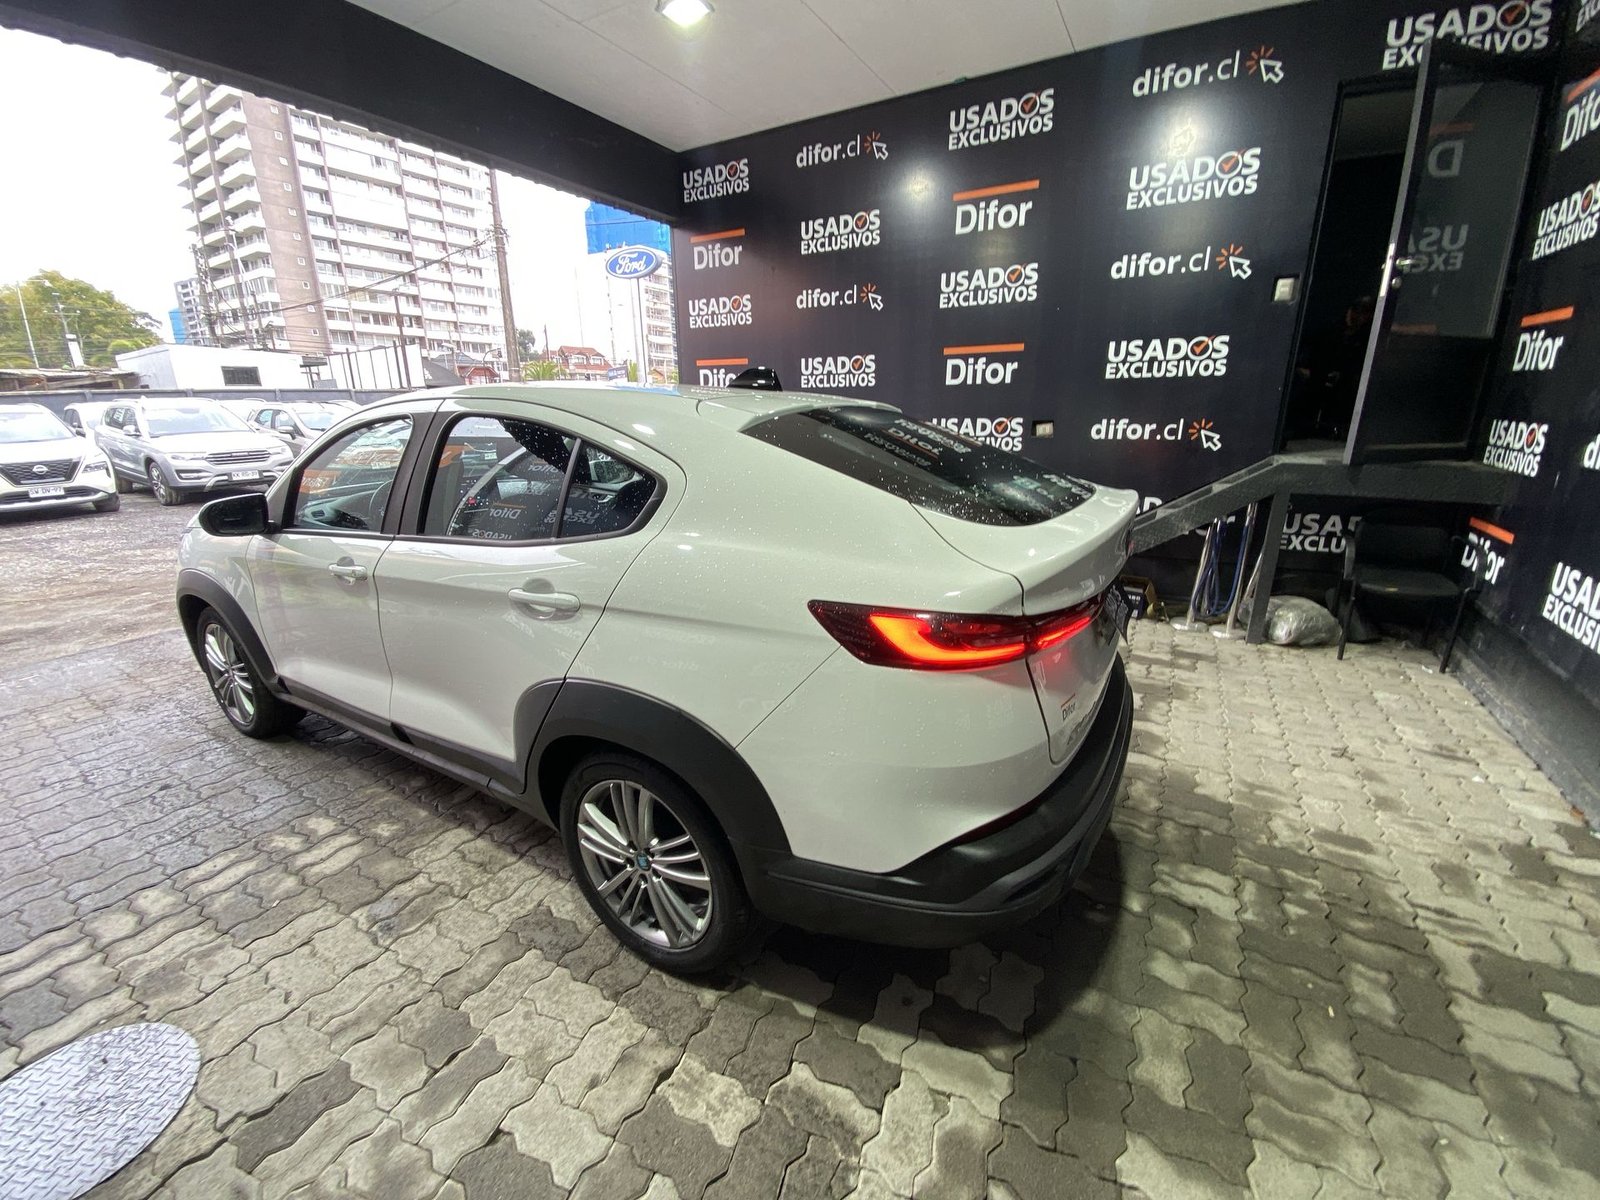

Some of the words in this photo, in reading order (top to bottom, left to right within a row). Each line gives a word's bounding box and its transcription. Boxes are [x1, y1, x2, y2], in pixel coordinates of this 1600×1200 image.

[1386, 0, 1552, 47] USADOS
[1132, 50, 1241, 97] difor.cl
[949, 88, 1055, 132] USADOS
[1560, 89, 1600, 151] Difo
[948, 121, 1053, 151] EXCLUSIVOS
[796, 135, 860, 168] difor.cl
[683, 158, 749, 189] USADOS
[1129, 147, 1261, 192] USADOS
[683, 178, 750, 203] EXCLUSIVOS
[1126, 174, 1258, 211] EXCLUSIVOS
[801, 209, 881, 241] USADOS
[955, 199, 1033, 235] Difor
[801, 229, 881, 255] EXCLUSIVOS
[1532, 212, 1600, 261] EXCLUSIVOS
[616, 252, 646, 274] Ford
[693, 242, 743, 270] Difor
[1110, 246, 1211, 281] difor.cl
[940, 263, 1039, 293] USADOS
[689, 294, 752, 317] USADOS
[796, 285, 858, 310] difor.cl
[939, 285, 1038, 309] EXCLUSIVOS
[689, 312, 753, 329] EXCLUSIVOS
[801, 354, 876, 374] USADOS
[1107, 335, 1230, 363] USADOS
[1512, 329, 1564, 372] Difor
[801, 372, 876, 388] EXCLUSIVOS
[945, 358, 1018, 386] Difor
[1105, 358, 1228, 380] EXCLUSIVOS
[1090, 418, 1184, 442] difor.cl
[1488, 419, 1549, 455] USADOS
[1483, 446, 1542, 478] EXCLUSIVOS
[1282, 513, 1362, 537] USA
[1280, 535, 1347, 553] EXCLU
[1551, 562, 1600, 620] USA
[1542, 593, 1600, 655] EXCLUSI
